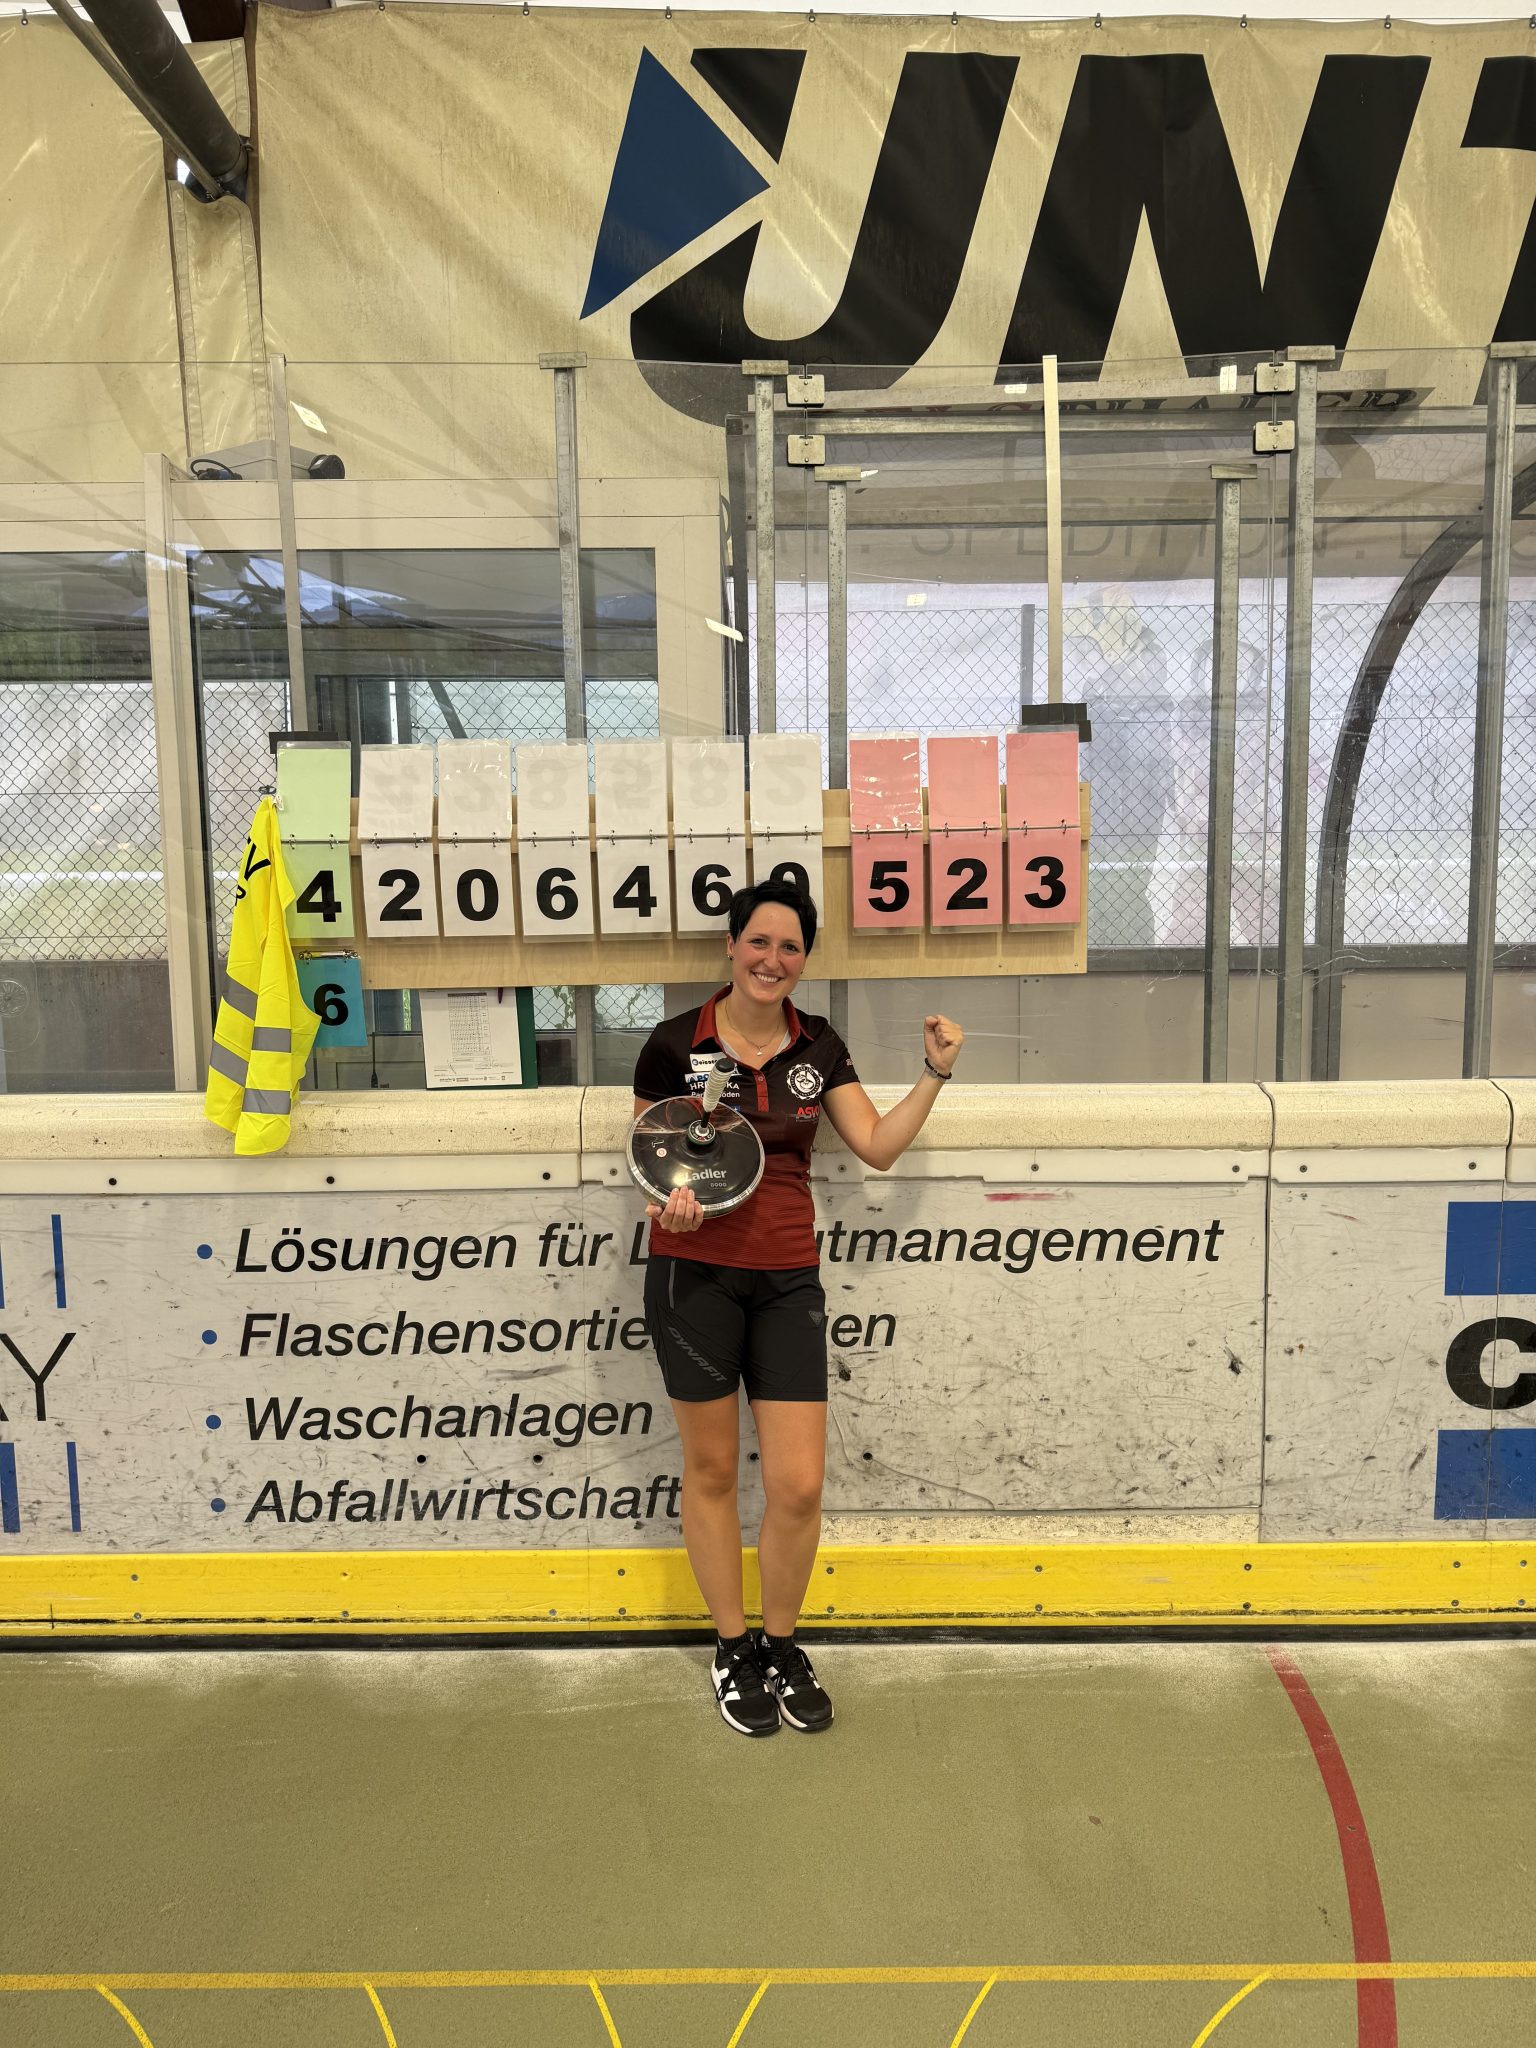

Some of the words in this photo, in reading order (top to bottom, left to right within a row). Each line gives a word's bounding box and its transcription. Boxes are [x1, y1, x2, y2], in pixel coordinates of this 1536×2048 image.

[314, 984, 349, 1026] 6
[236, 1228, 516, 1281] Lösungen
[539, 1222, 614, 1267] für
[629, 1219, 1224, 1274] Ltmanagement
[246, 1394, 653, 1448] Waschanlagen
[245, 1475, 682, 1523] Abfallwirtschaft
